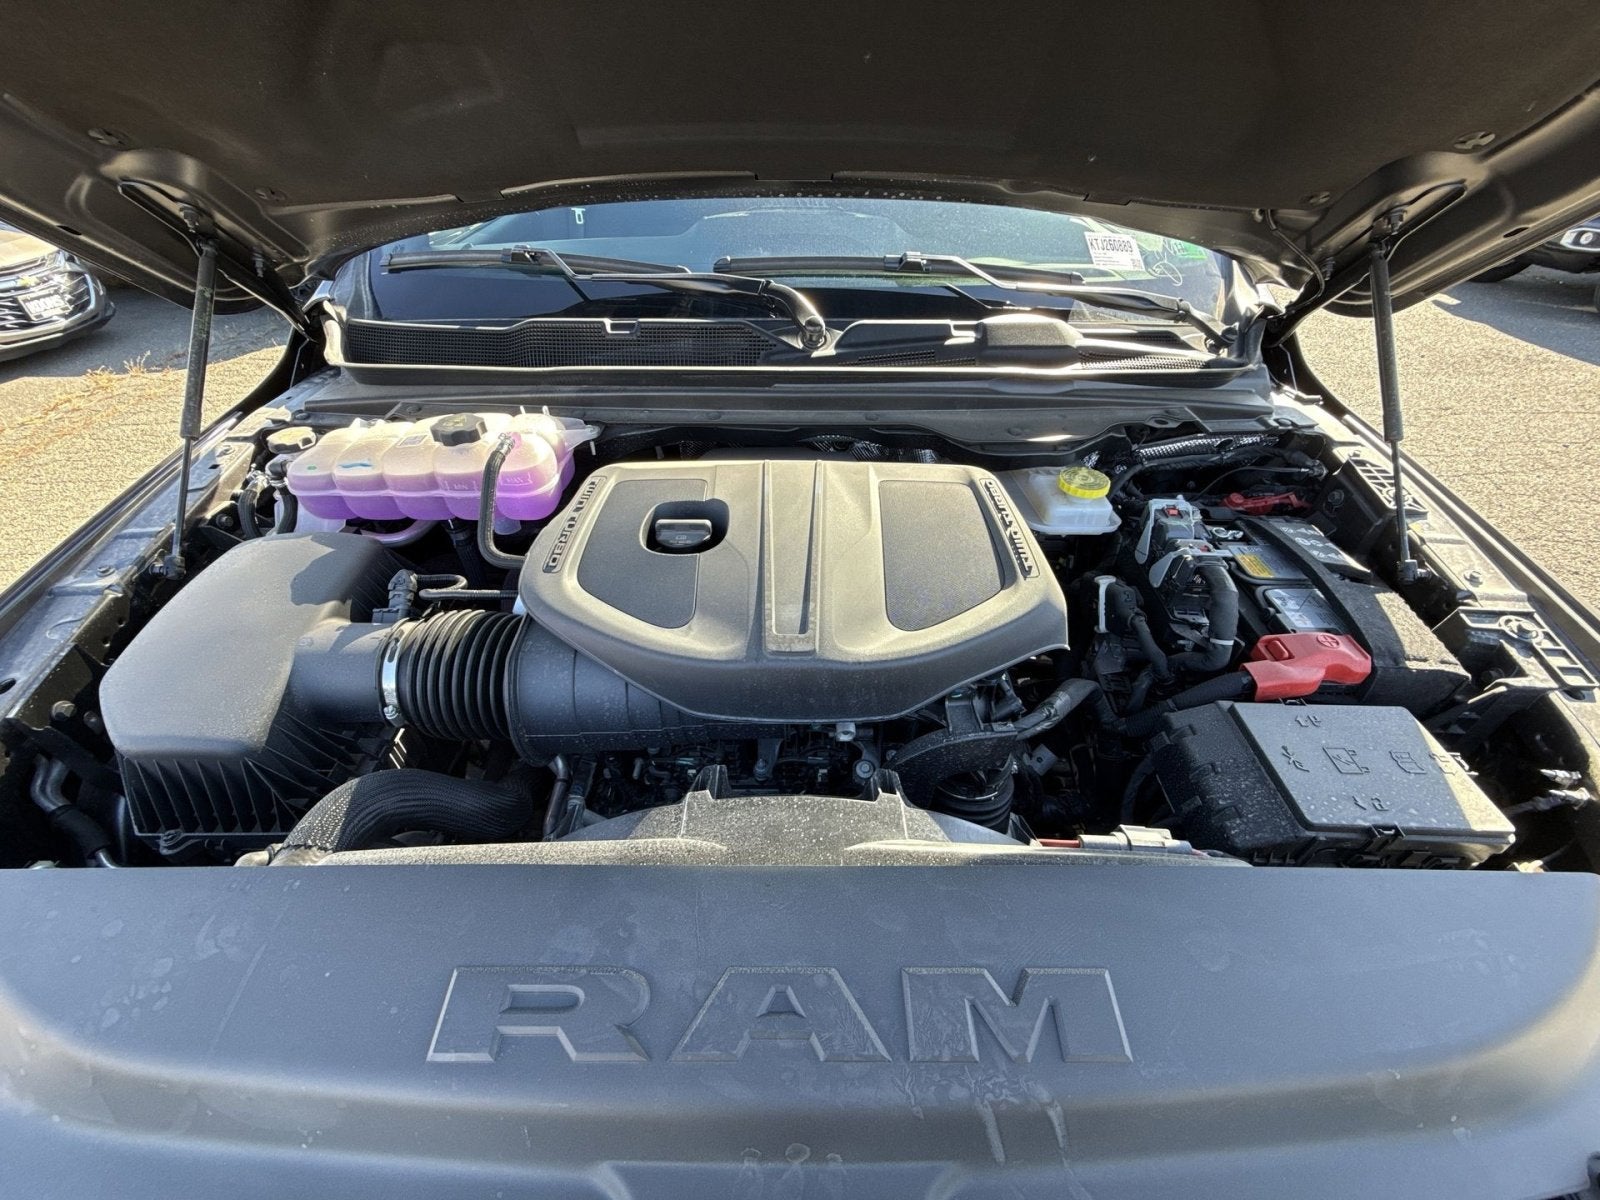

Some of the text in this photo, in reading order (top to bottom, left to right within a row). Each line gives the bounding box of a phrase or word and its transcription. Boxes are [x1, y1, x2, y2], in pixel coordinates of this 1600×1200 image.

[548, 515, 578, 567] TURBO
[985, 479, 1032, 573] TWIN TURBO
[426, 966, 1134, 1063] RAM
